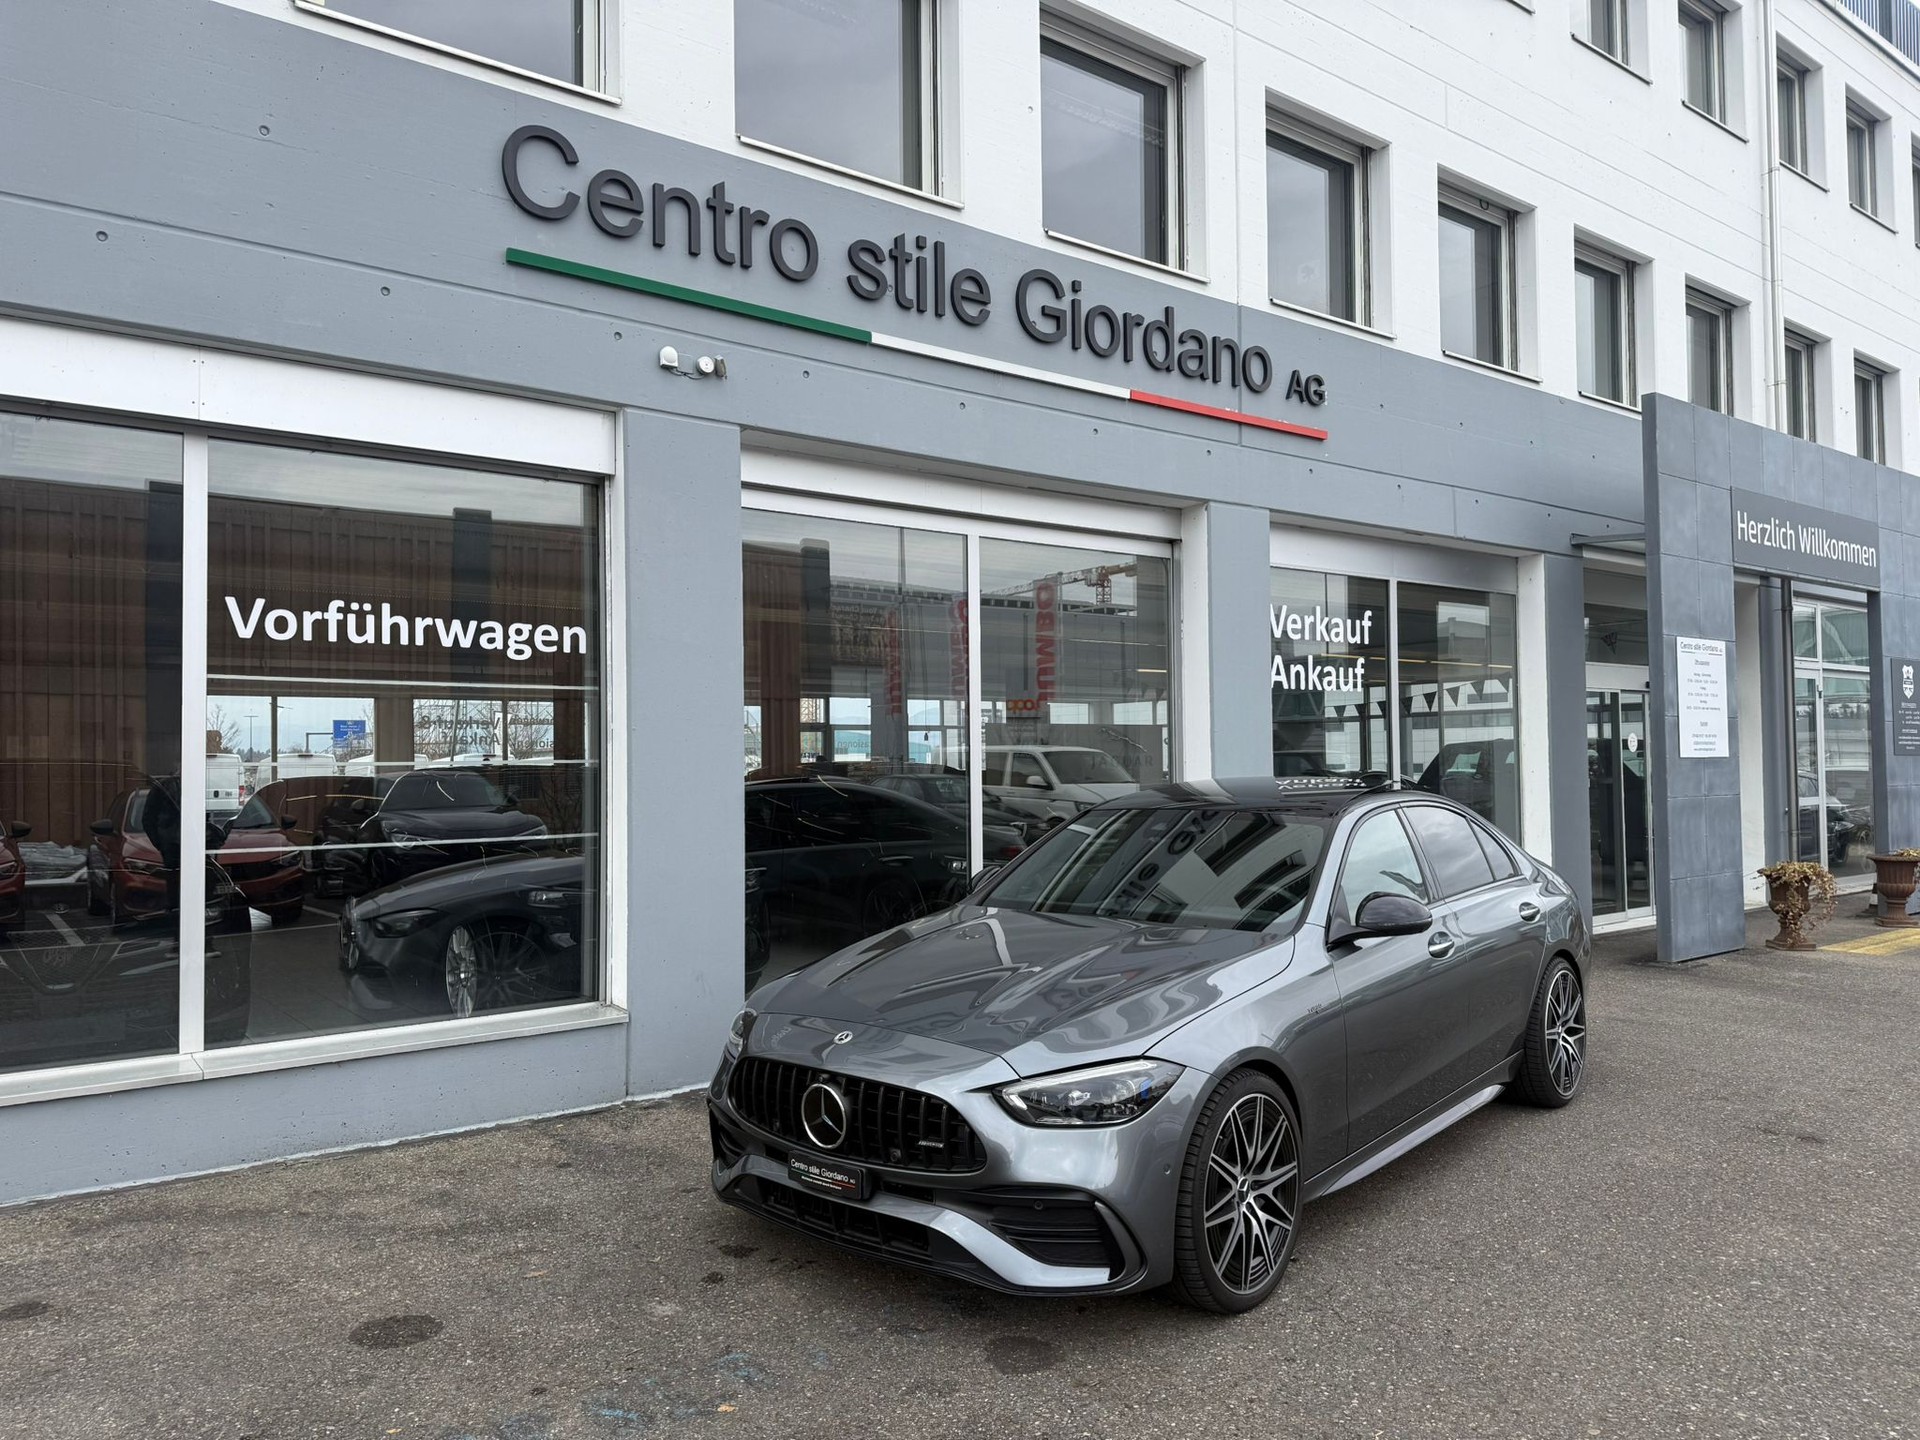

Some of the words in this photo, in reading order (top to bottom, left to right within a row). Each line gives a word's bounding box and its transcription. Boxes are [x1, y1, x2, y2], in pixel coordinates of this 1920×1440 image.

[501, 124, 819, 282] Centro
[846, 232, 991, 327] stile
[1014, 268, 1273, 393] Giordano
[1285, 369, 1327, 405] AG
[1737, 510, 1796, 551] Herzlich
[1798, 524, 1877, 568] Willkommen
[225, 596, 587, 661] Vorführwagen
[1270, 603, 1373, 645] Verkauf
[1270, 654, 1365, 693] Ankauf
